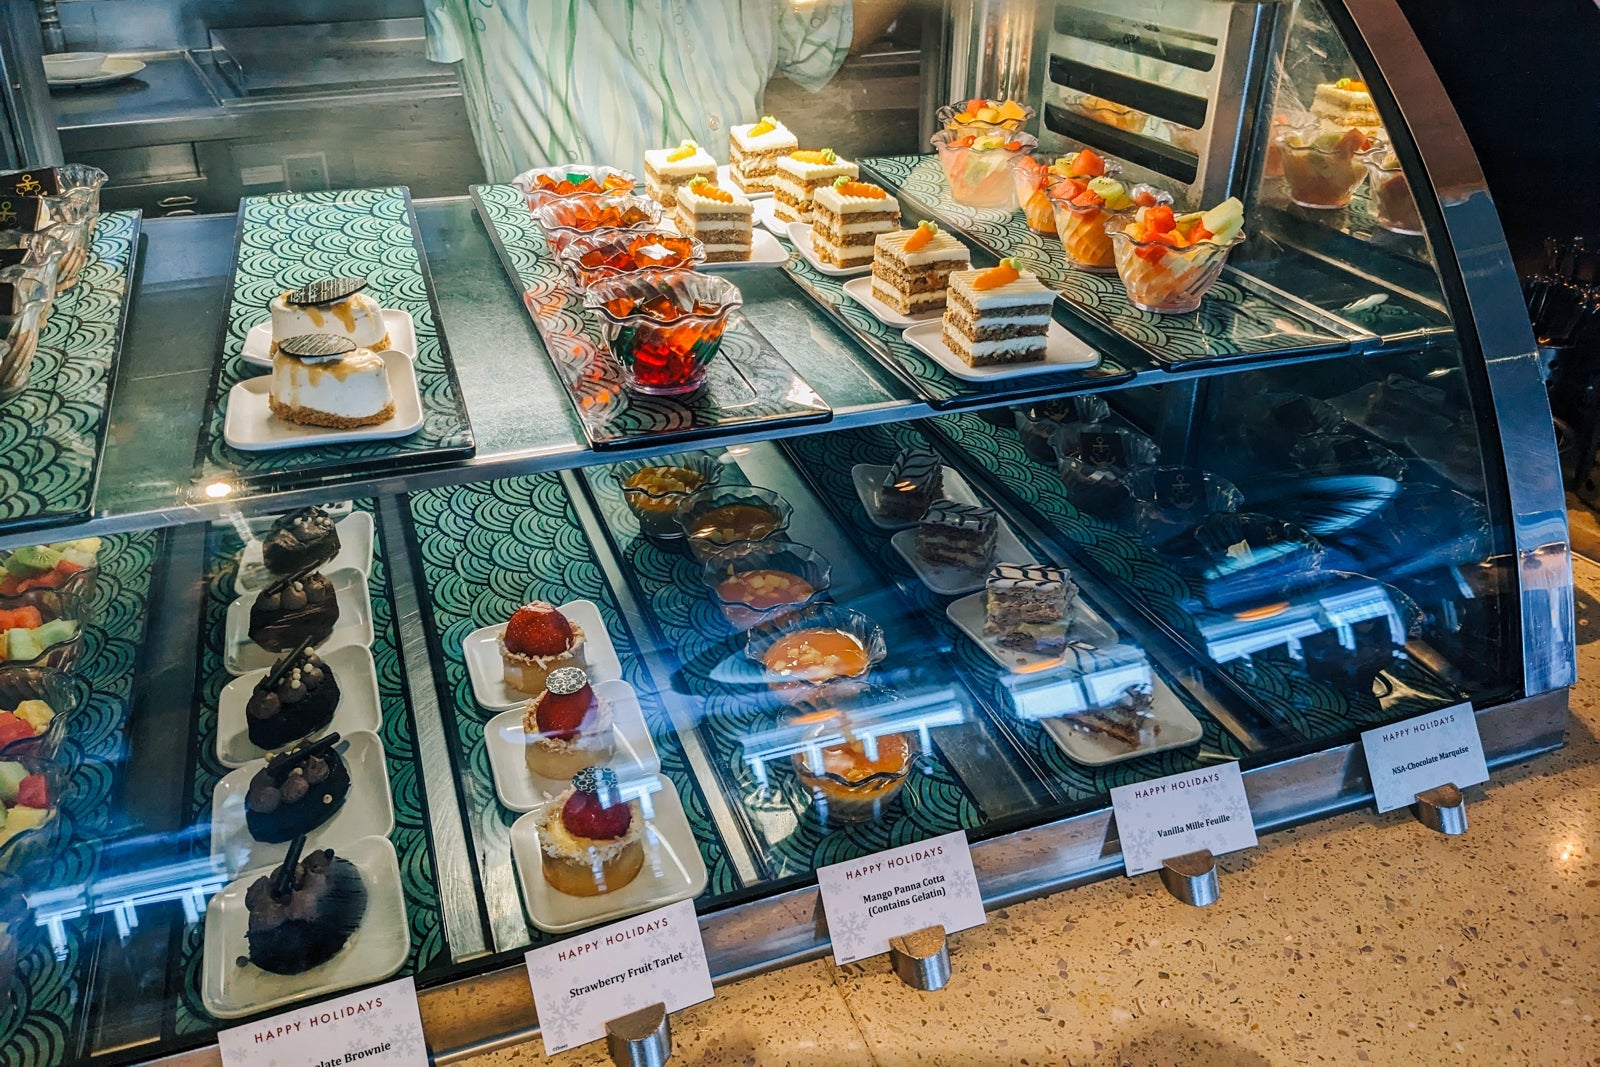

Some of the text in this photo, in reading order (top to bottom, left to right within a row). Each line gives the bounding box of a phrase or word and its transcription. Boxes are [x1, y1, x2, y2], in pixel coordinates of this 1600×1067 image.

[1382, 714, 1455, 742] HAPPY HOLIDAYS
[1392, 745, 1469, 775] NSA-Chocolate Marquise
[1135, 773, 1220, 799] HAPPY HOLIDAYS
[1157, 814, 1231, 838] Vanilla Mille Feuille
[845, 846, 943, 880] HAPPY HOLIDAYS
[863, 874, 945, 904] Mango Panna Cotta
[868, 886, 946, 918] (Contains Gelatin)
[558, 917, 669, 962] HAPPY HOLIDAYS
[569, 951, 683, 998] Strawberry Fruit Tarlet
[254, 997, 383, 1043] HAPPY HOLIDAYS
[344, 1041, 391, 1064] Brownie
